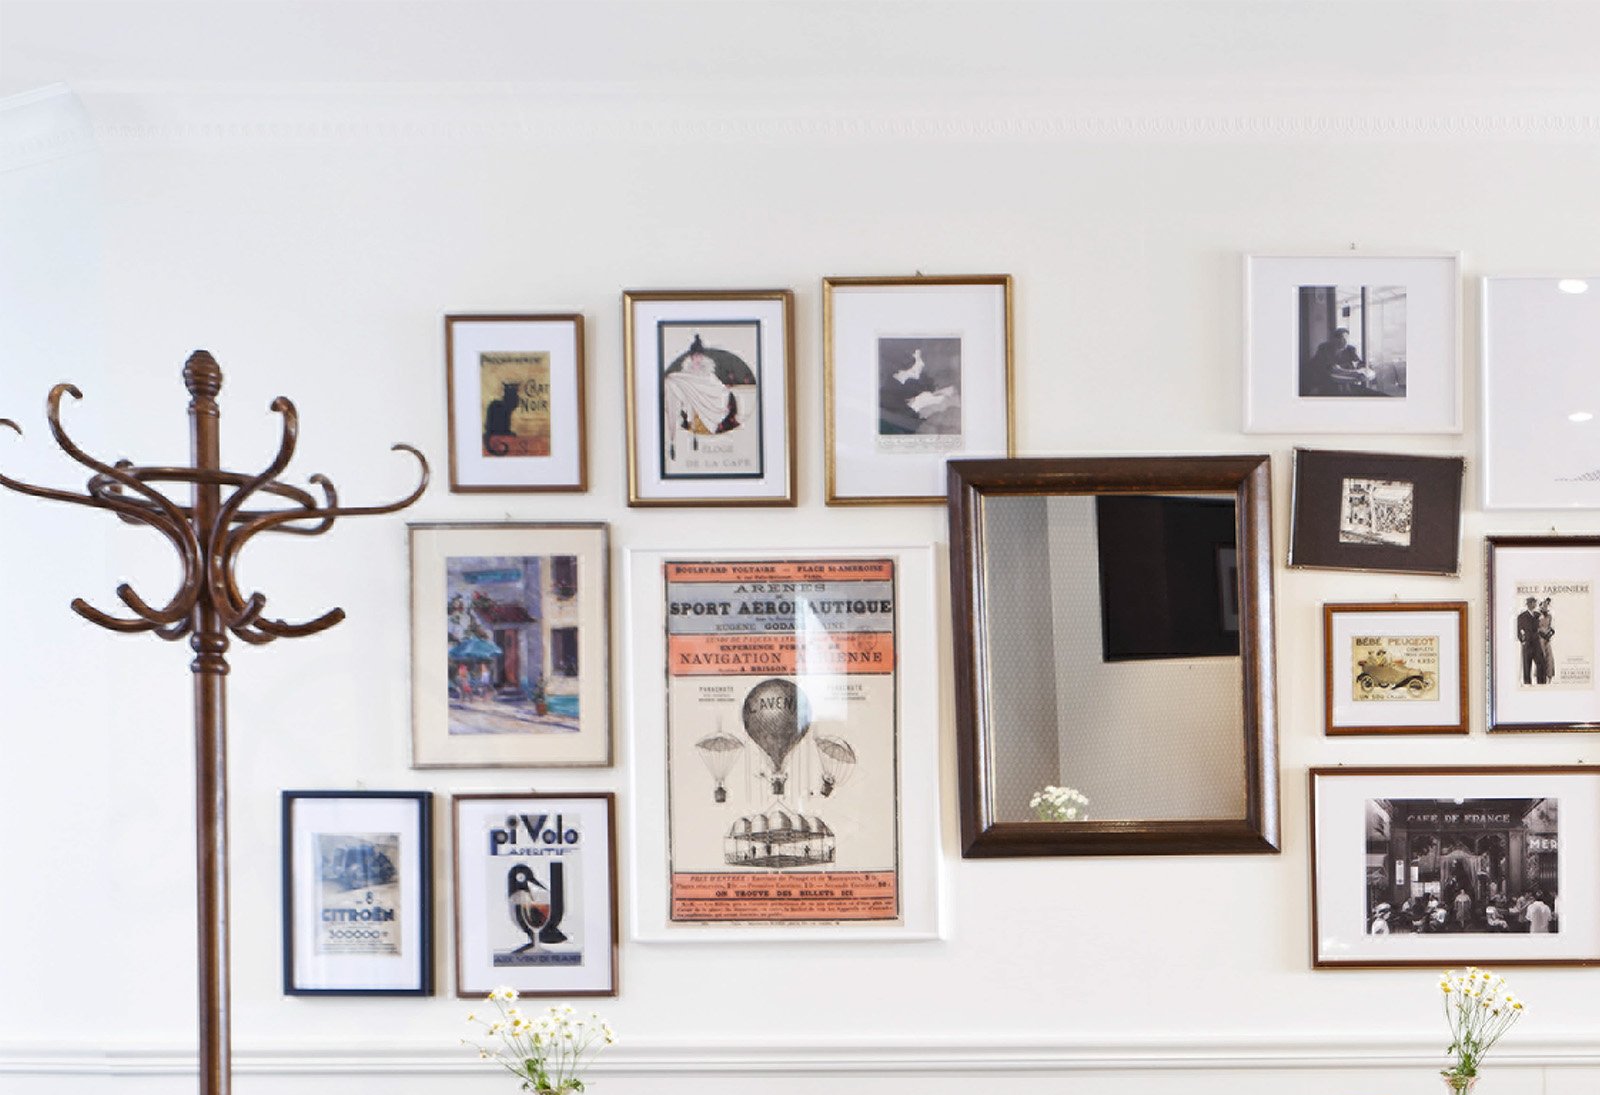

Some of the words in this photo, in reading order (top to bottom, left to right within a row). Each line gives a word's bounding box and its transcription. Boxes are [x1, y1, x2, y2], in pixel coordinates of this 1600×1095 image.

[670, 602, 731, 615] SPORT
[1387, 637, 1434, 646] PEUGEOT
[680, 653, 782, 664] NAVIGATION
[1464, 814, 1511, 823] FRANCE
